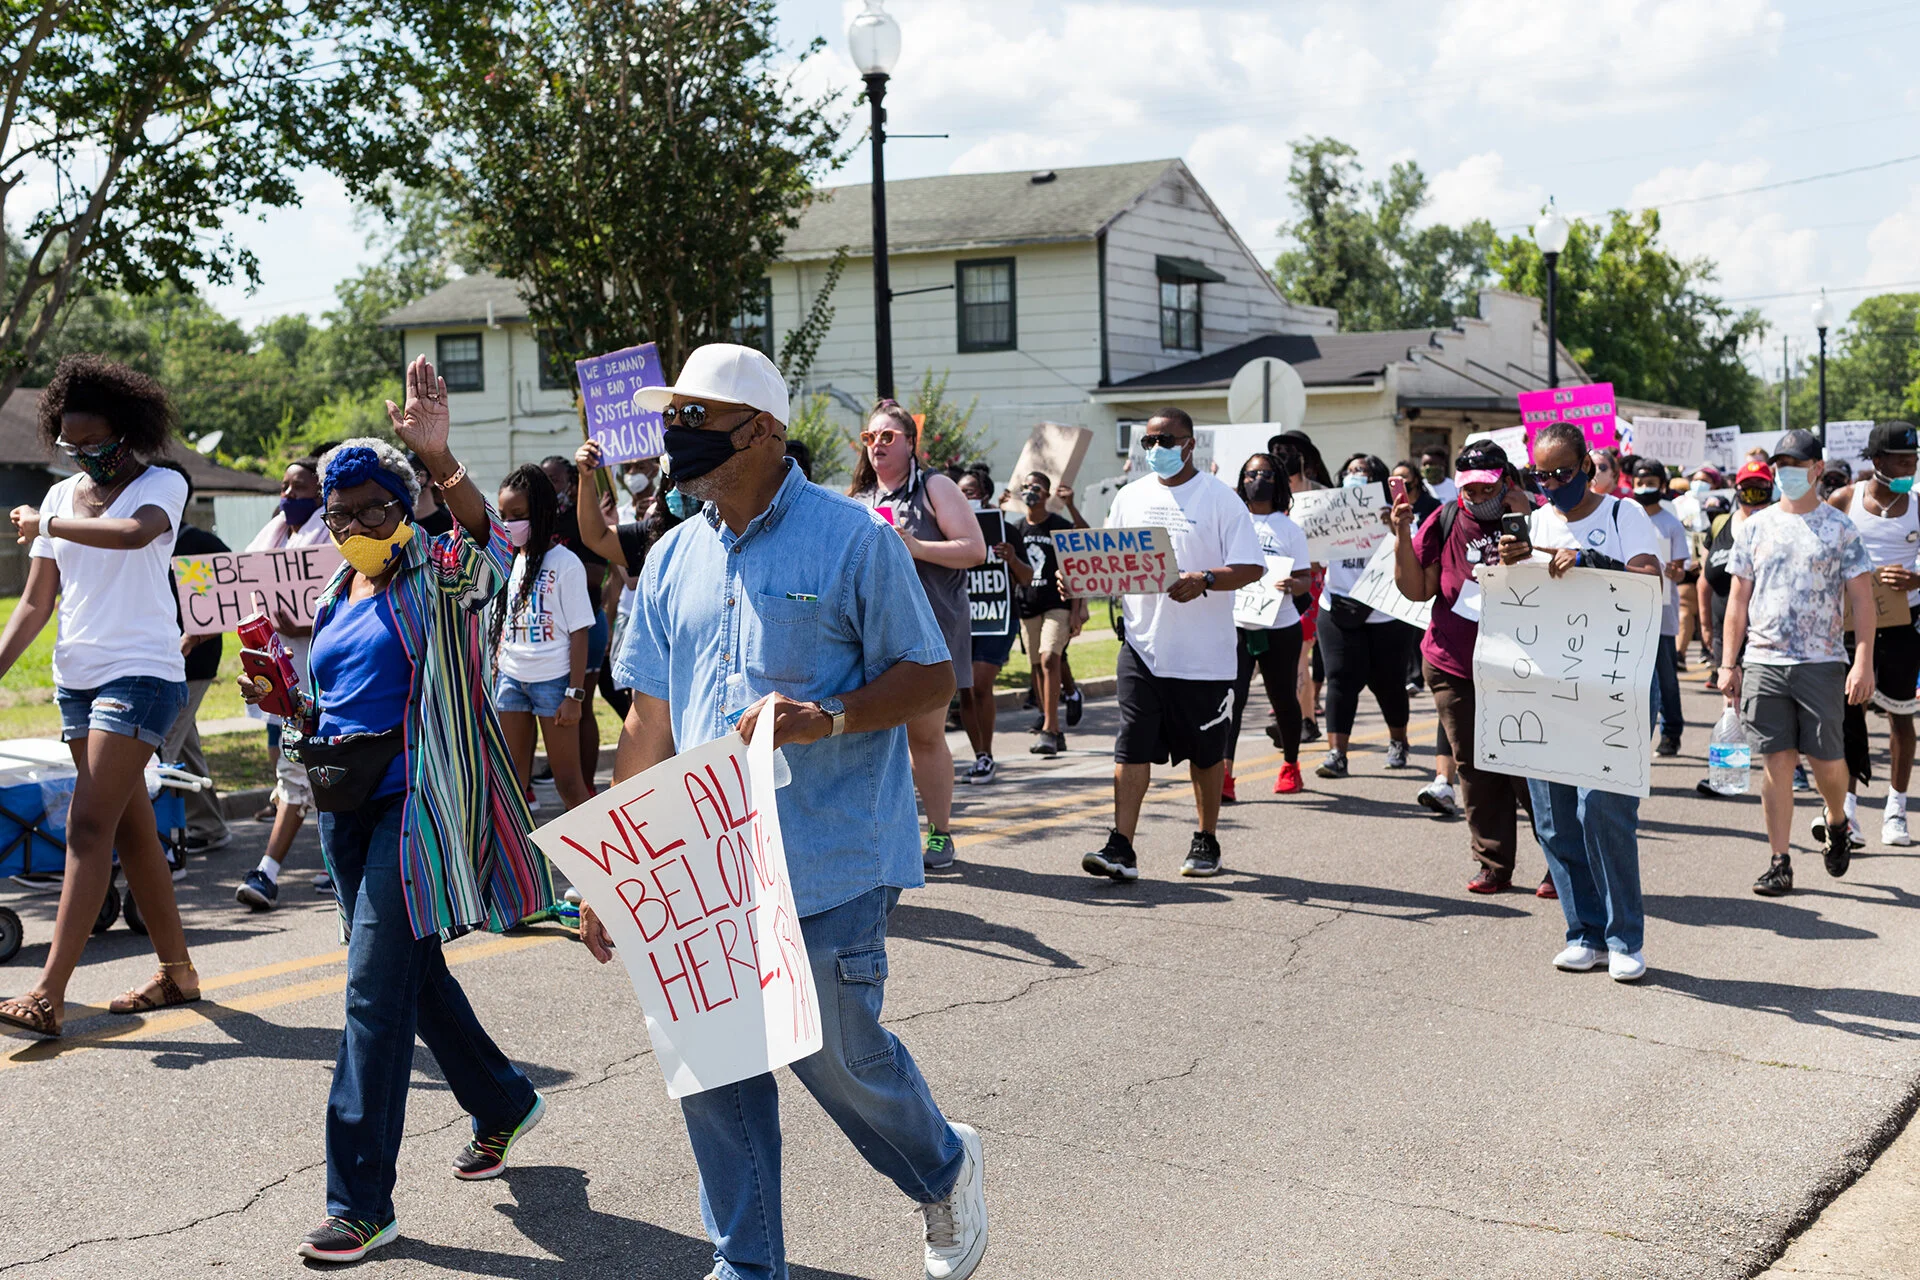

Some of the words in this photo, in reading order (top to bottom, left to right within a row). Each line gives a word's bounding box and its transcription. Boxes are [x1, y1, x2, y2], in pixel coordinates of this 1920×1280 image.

[584, 365, 600, 381] WE
[605, 355, 646, 377] DEMAND
[590, 385, 602, 398] AN
[606, 379, 625, 396] END
[629, 376, 643, 389] TO
[597, 418, 665, 458] RACISM
[1638, 420, 1674, 439] FUCK
[1675, 423, 1697, 439] THE
[1352, 487, 1373, 508] &
[1054, 530, 1155, 553] RENAME
[212, 555, 259, 584] BE
[265, 550, 323, 583] THE
[1063, 552, 1166, 577] FORREST
[1070, 572, 1166, 595] COUNTY
[189, 586, 319, 627] CHANG
[970, 600, 1007, 620] RDAY
[560, 788, 687, 876] WE
[683, 754, 758, 840] ALL
